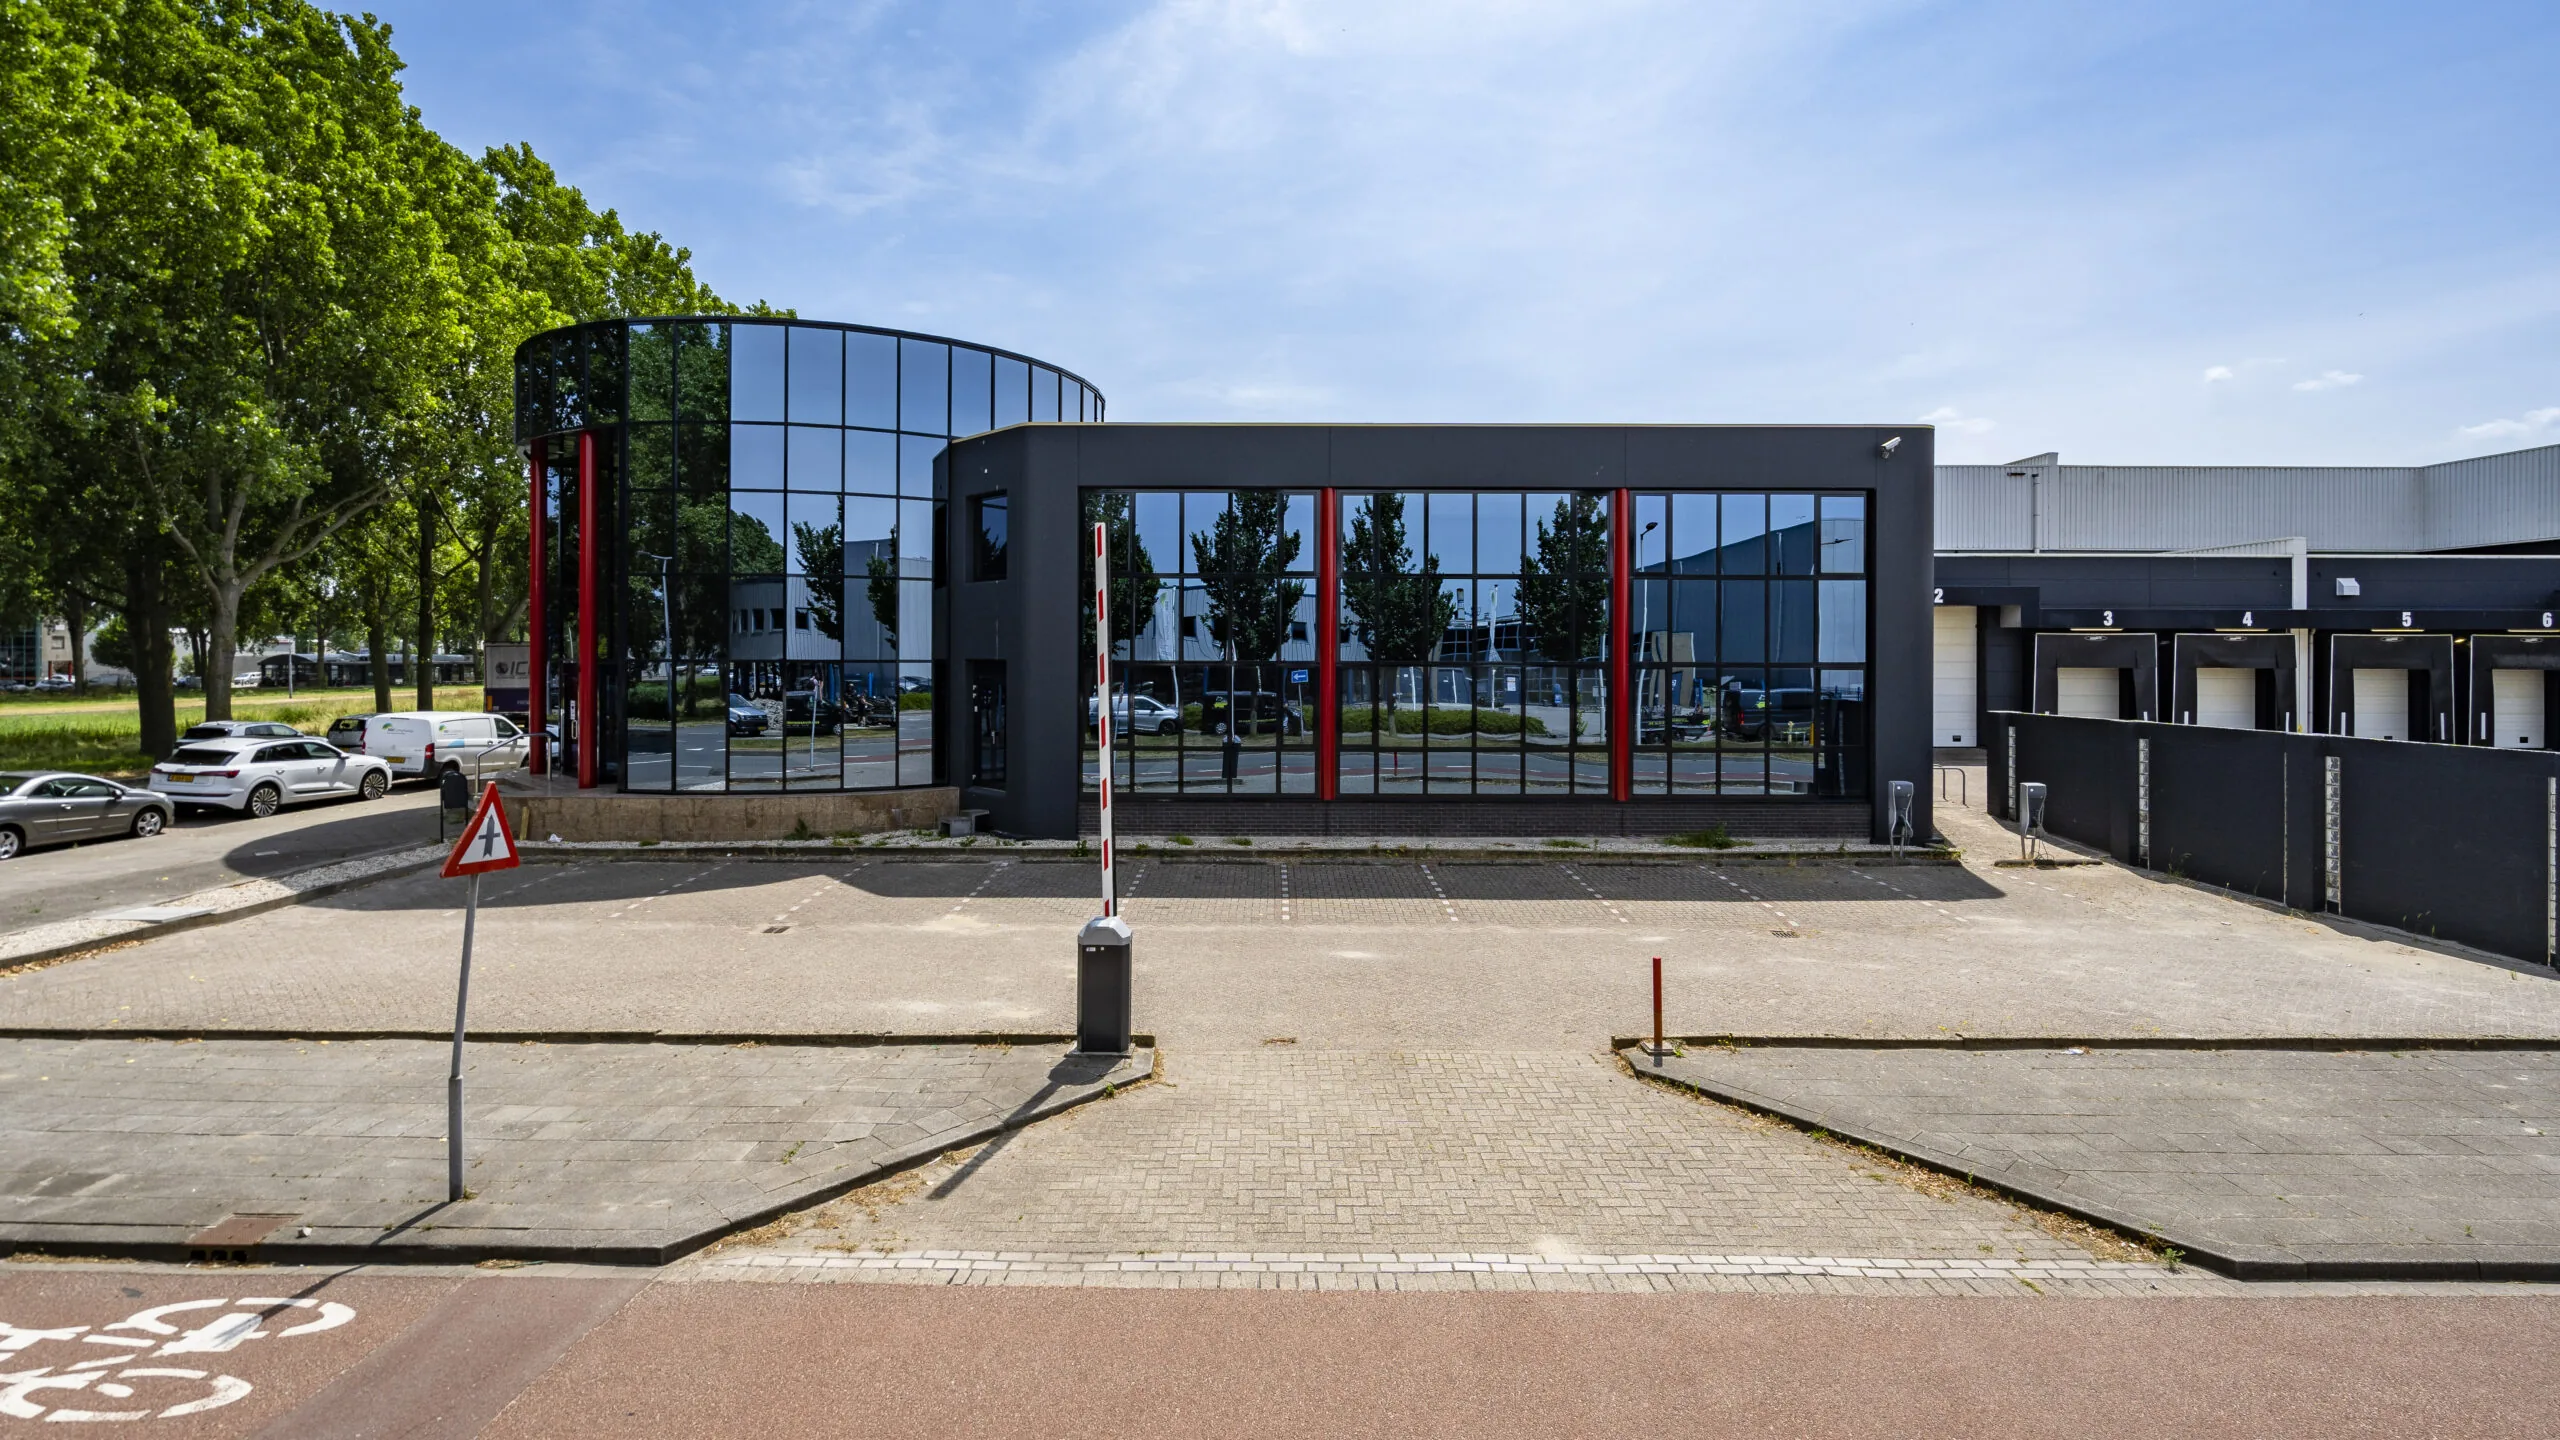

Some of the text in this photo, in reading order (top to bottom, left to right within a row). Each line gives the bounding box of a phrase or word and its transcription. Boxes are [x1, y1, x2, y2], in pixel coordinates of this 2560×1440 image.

[1934, 588, 1943, 603] 2
[2104, 611, 2112, 626] 3
[2243, 612, 2252, 626] 4
[2402, 612, 2411, 627] 5
[2543, 613, 2552, 627] 6
[510, 660, 531, 675] IC
